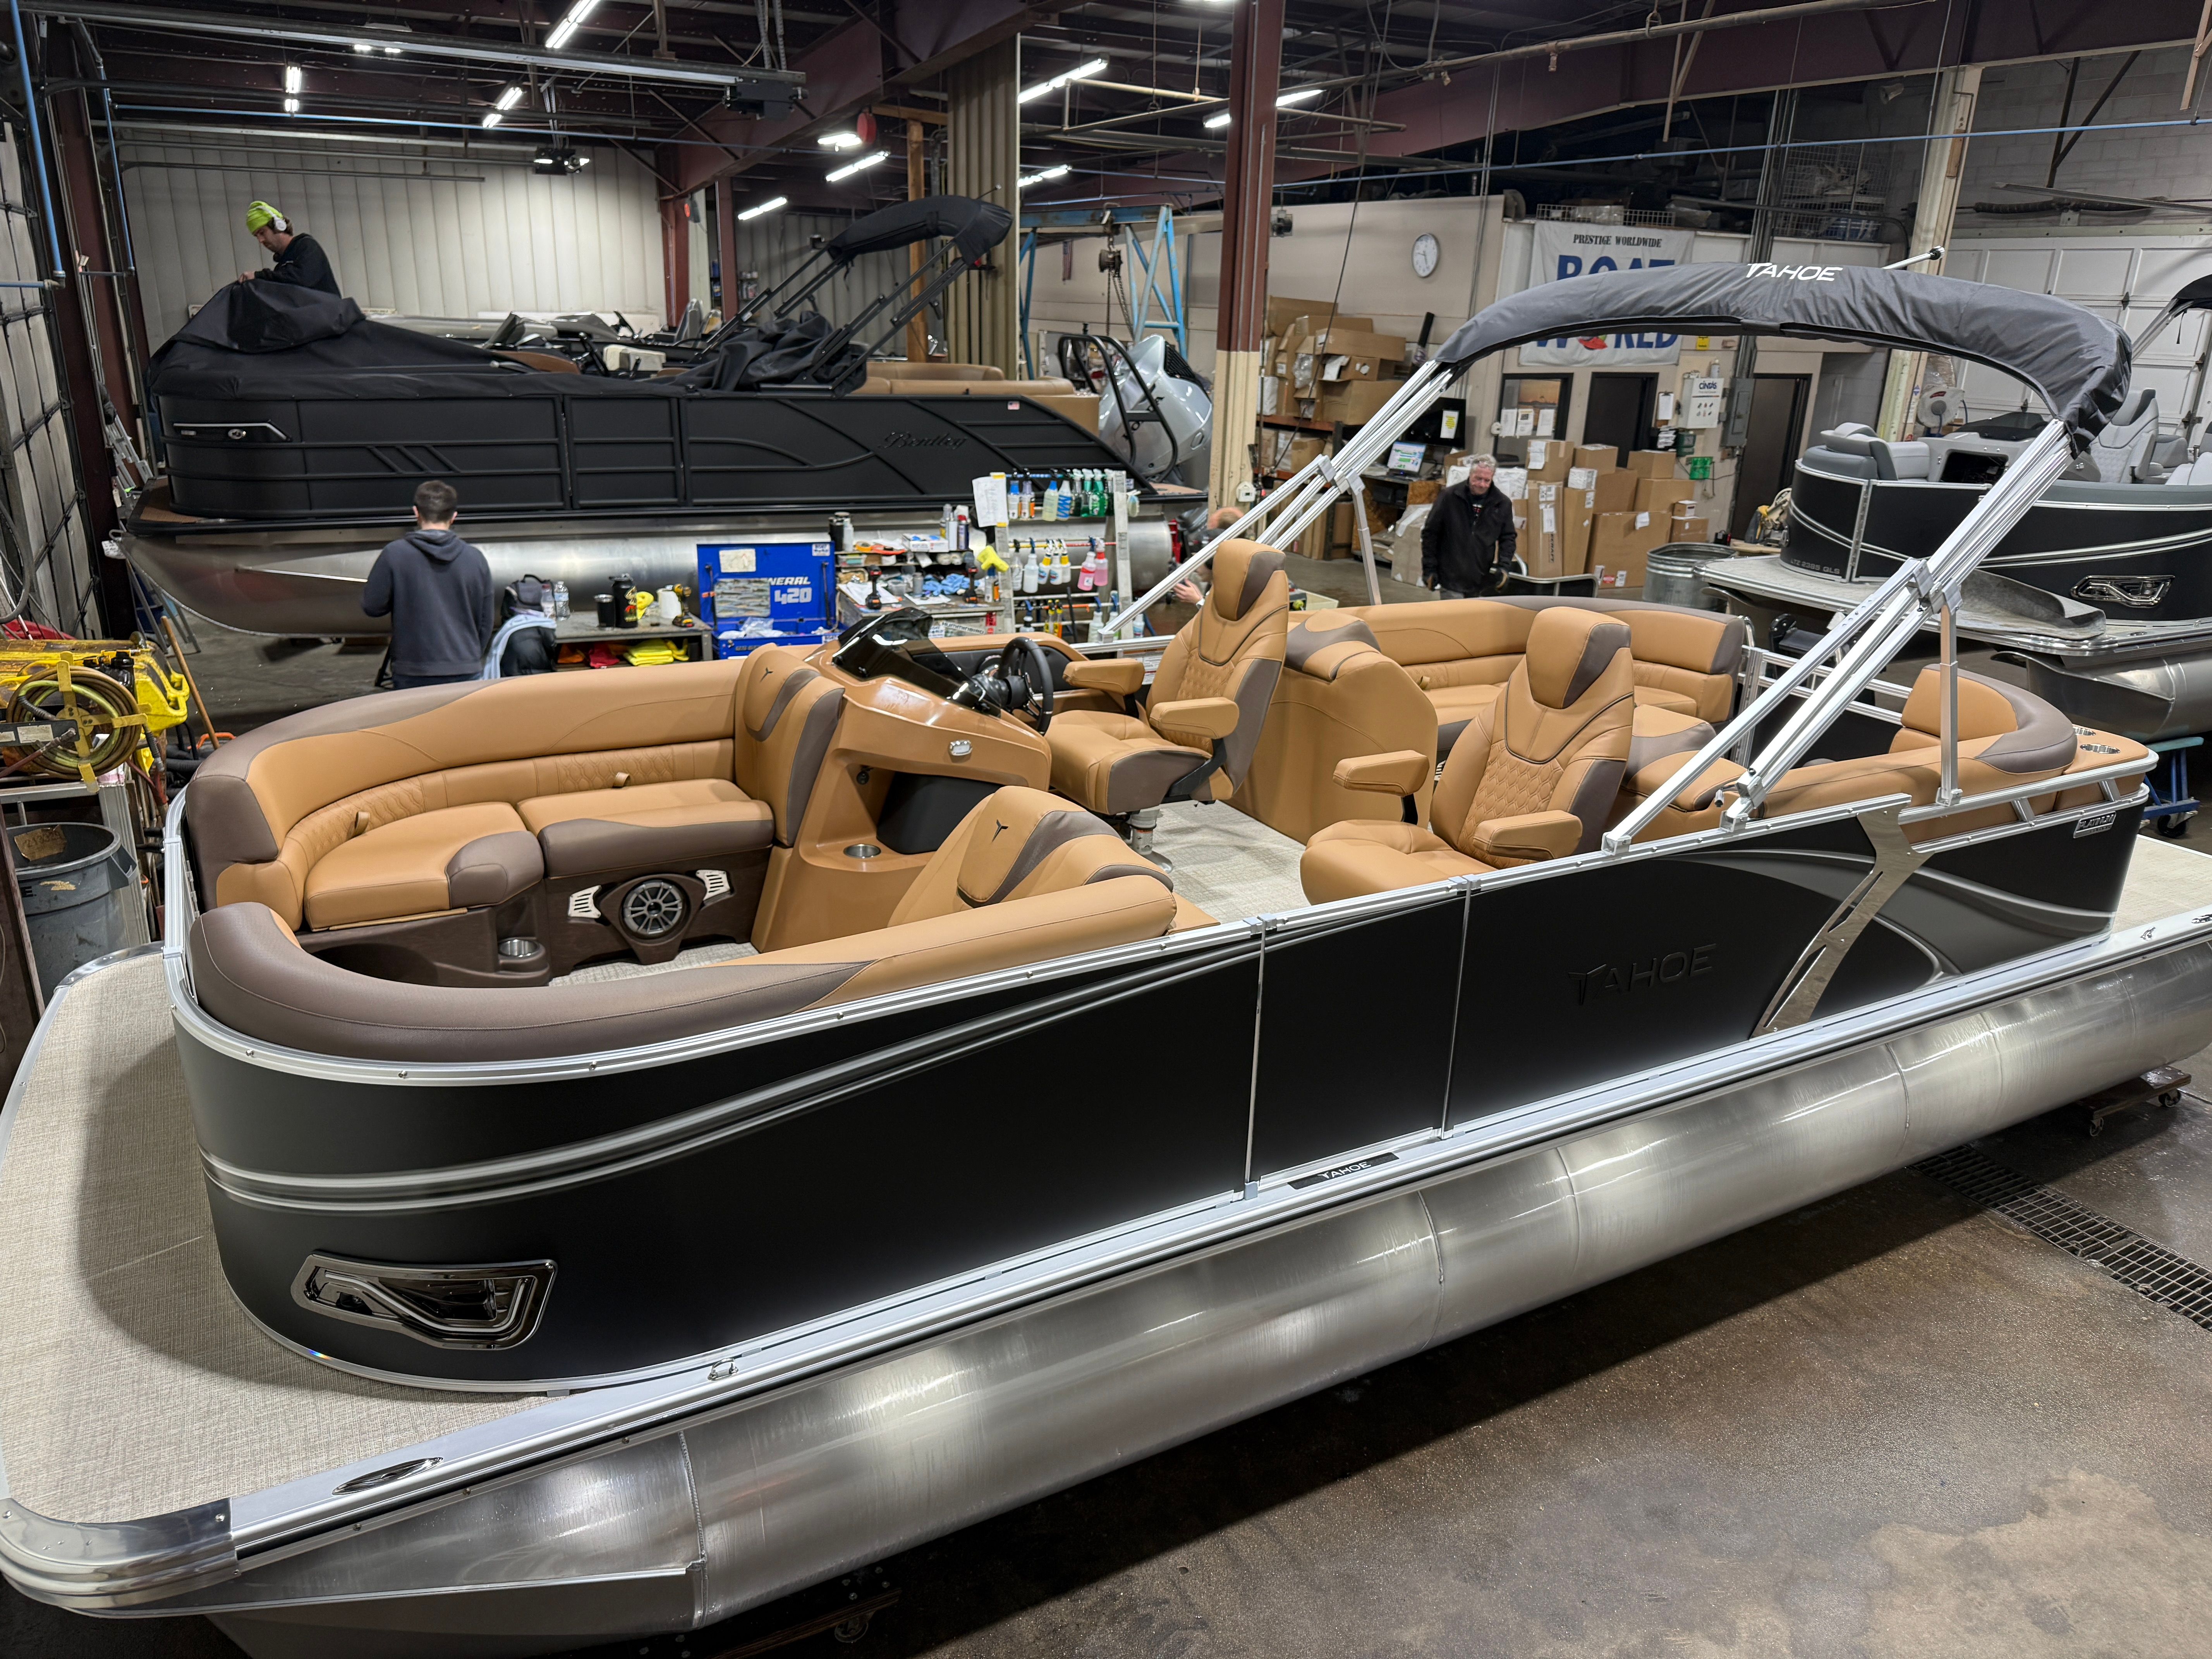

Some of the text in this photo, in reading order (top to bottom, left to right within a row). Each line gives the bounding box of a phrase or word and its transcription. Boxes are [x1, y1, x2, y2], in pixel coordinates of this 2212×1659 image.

[1573, 234, 1662, 248] PRESTIGE WORLDWIDE
[1746, 263, 1843, 281] TAHOE
[775, 587, 812, 605] 420
[1568, 943, 1716, 1006] TAHOE
[1317, 1161, 1371, 1179] TAHOE
